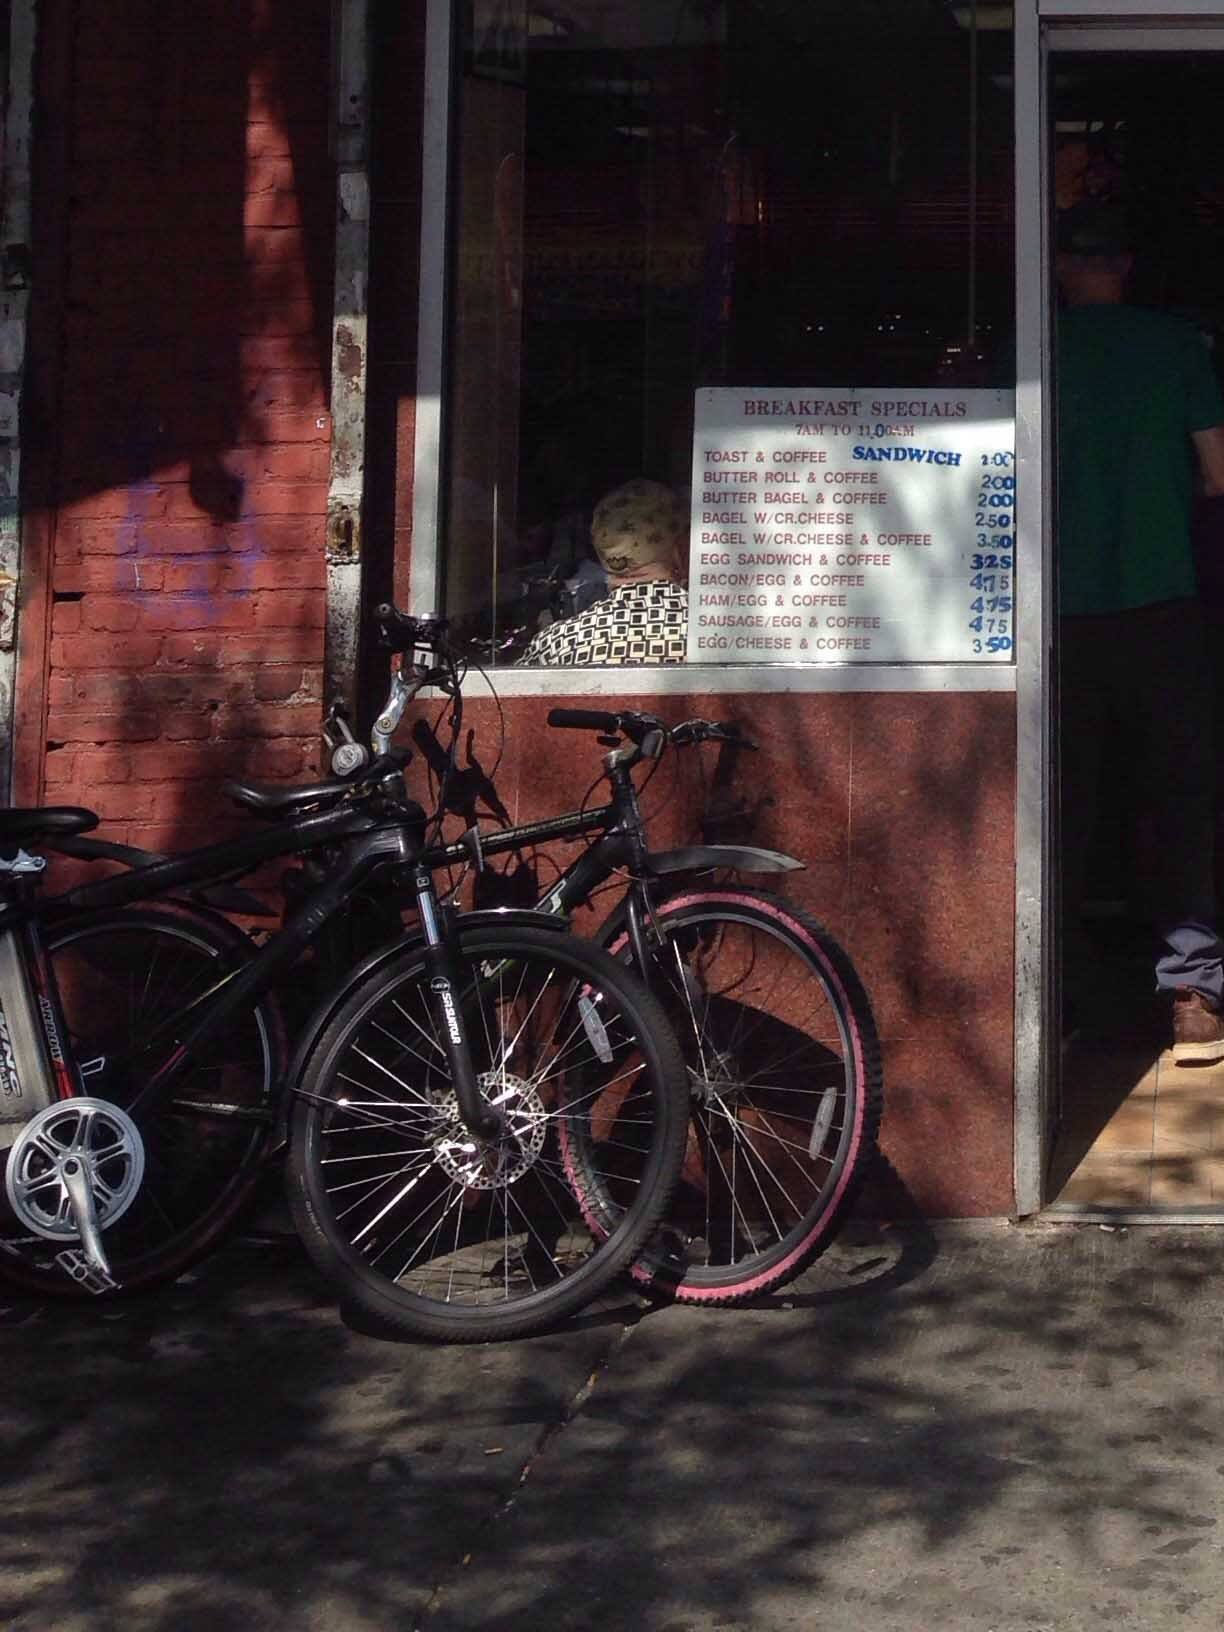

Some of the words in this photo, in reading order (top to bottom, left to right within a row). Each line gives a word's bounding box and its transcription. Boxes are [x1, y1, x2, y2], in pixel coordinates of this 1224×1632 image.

[744, 400, 862, 416] BREAKFAST
[871, 401, 967, 417] SPECIALS
[795, 424, 824, 436] 7AM
[832, 424, 851, 437] TO
[704, 451, 747, 463] TOAST
[755, 451, 764, 463] &
[772, 451, 827, 463] COFFEE
[852, 446, 962, 466] SANDWICH
[703, 472, 758, 484] BUTTER
[764, 472, 800, 484] ROLL
[807, 472, 816, 484] &
[824, 472, 878, 484] COFFEE
[702, 492, 757, 504] BUTTER
[764, 492, 809, 504] BAGEL
[816, 493, 825, 504] &
[832, 493, 887, 505] COFFEE
[702, 513, 747, 525] BAGEL
[701, 533, 746, 545] BAGEL
[860, 533, 869, 545] &
[877, 534, 931, 546] COFFEE
[701, 554, 730, 565] EGG
[737, 554, 812, 566] SANDWICH
[819, 554, 828, 566] &
[836, 554, 891, 566] COFFEE
[700, 574, 786, 586] BACON/EGG
[793, 574, 802, 586] &
[810, 574, 865, 587] COFFEE
[699, 595, 767, 608] HAM/EGG
[775, 595, 784, 607] &
[792, 595, 847, 608] COFFEE
[698, 615, 801, 628] SAUSAGE/EGG
[809, 616, 818, 628] &
[826, 616, 881, 628] COFFEE
[697, 637, 792, 649] EGG/CHEESE
[799, 637, 809, 649] &
[816, 637, 871, 650] COFFEE
